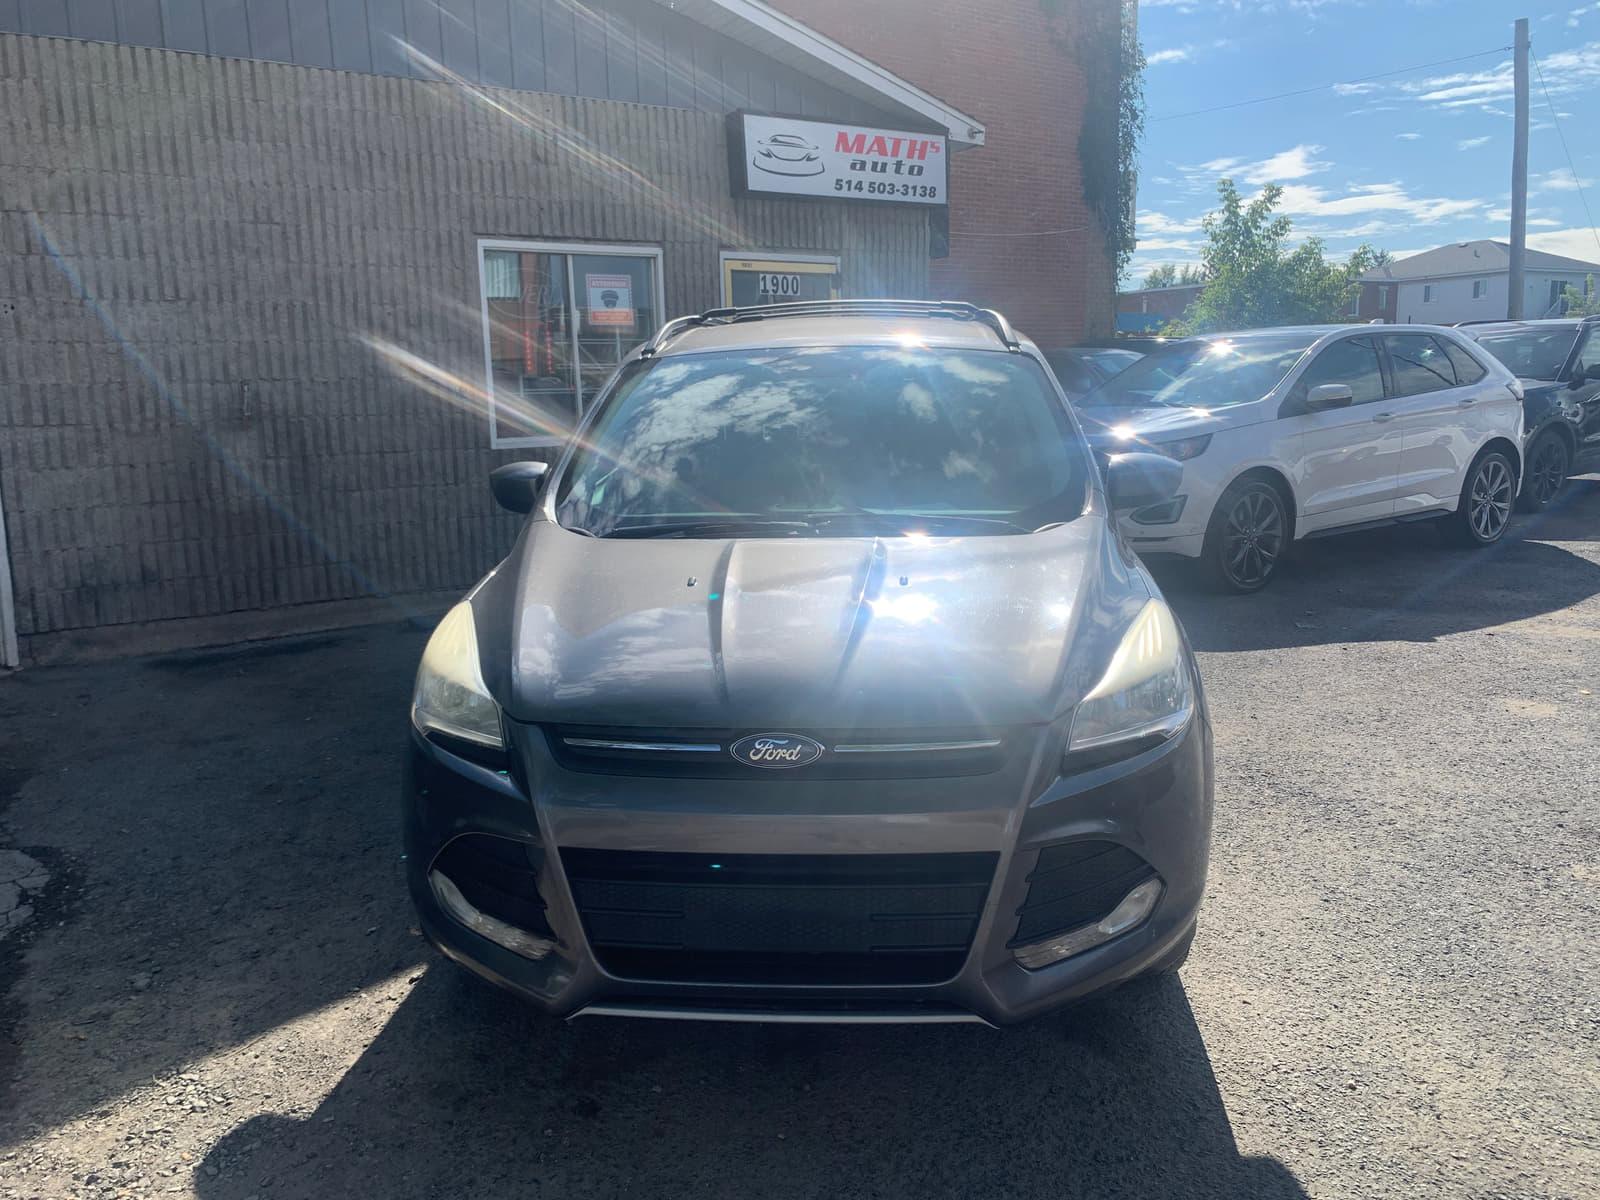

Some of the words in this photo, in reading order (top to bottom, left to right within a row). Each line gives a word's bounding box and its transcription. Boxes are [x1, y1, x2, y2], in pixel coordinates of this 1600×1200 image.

[850, 159, 924, 176] auto
[834, 178, 864, 193] 514
[867, 181, 936, 198] 503-3138
[760, 276, 799, 295] 1900
[749, 738, 802, 760] Ford
